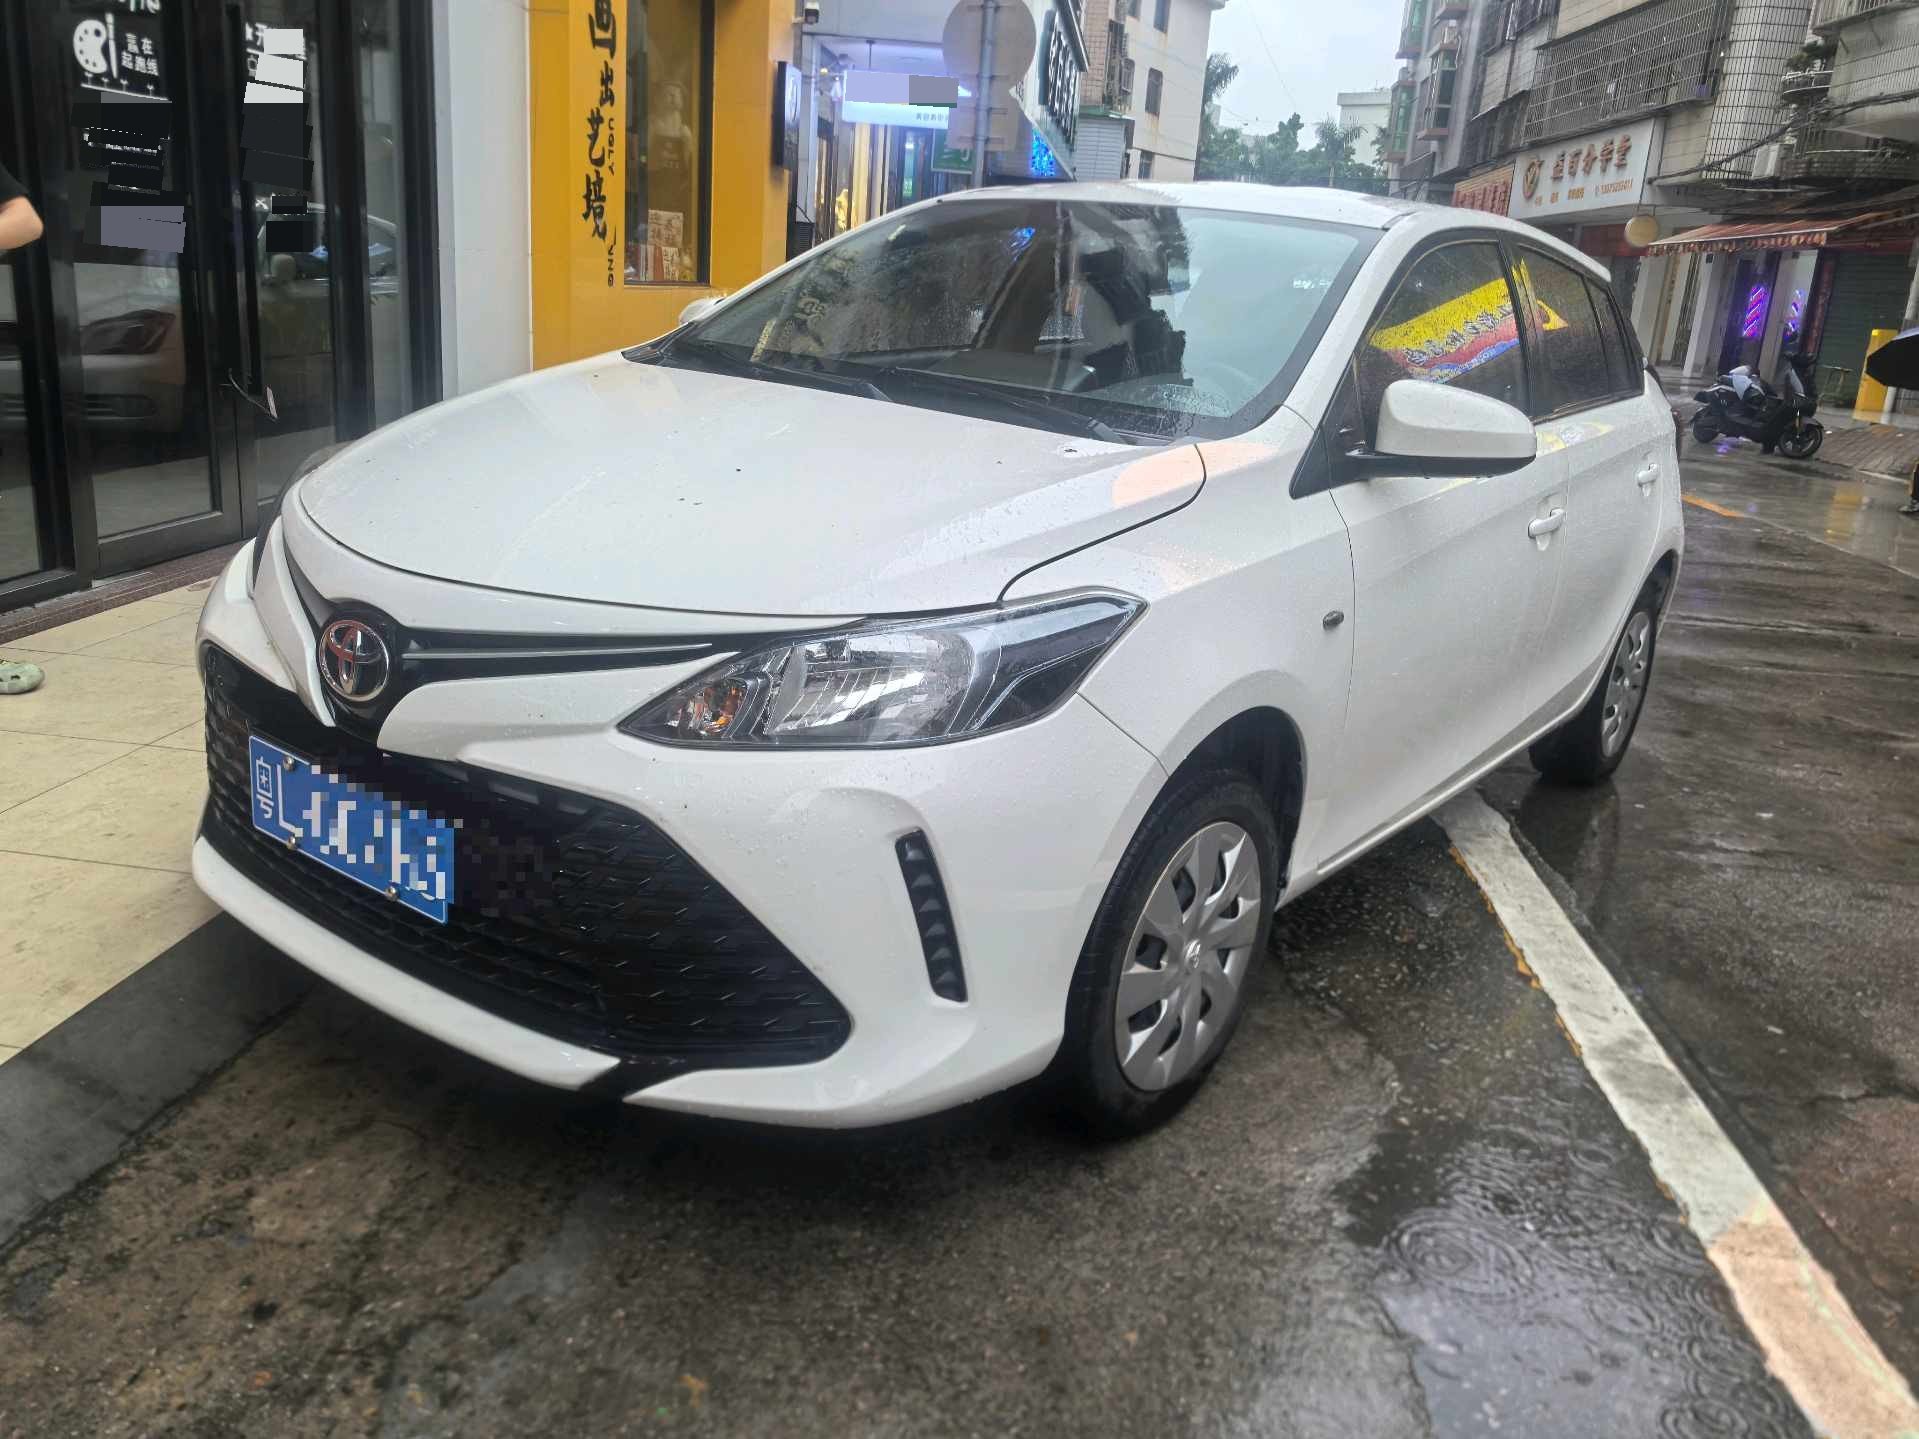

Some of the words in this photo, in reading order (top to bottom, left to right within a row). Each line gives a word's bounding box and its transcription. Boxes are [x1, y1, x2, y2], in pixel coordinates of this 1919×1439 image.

[125, 33, 153, 55] 赢在
[121, 51, 159, 76] 起跑线
